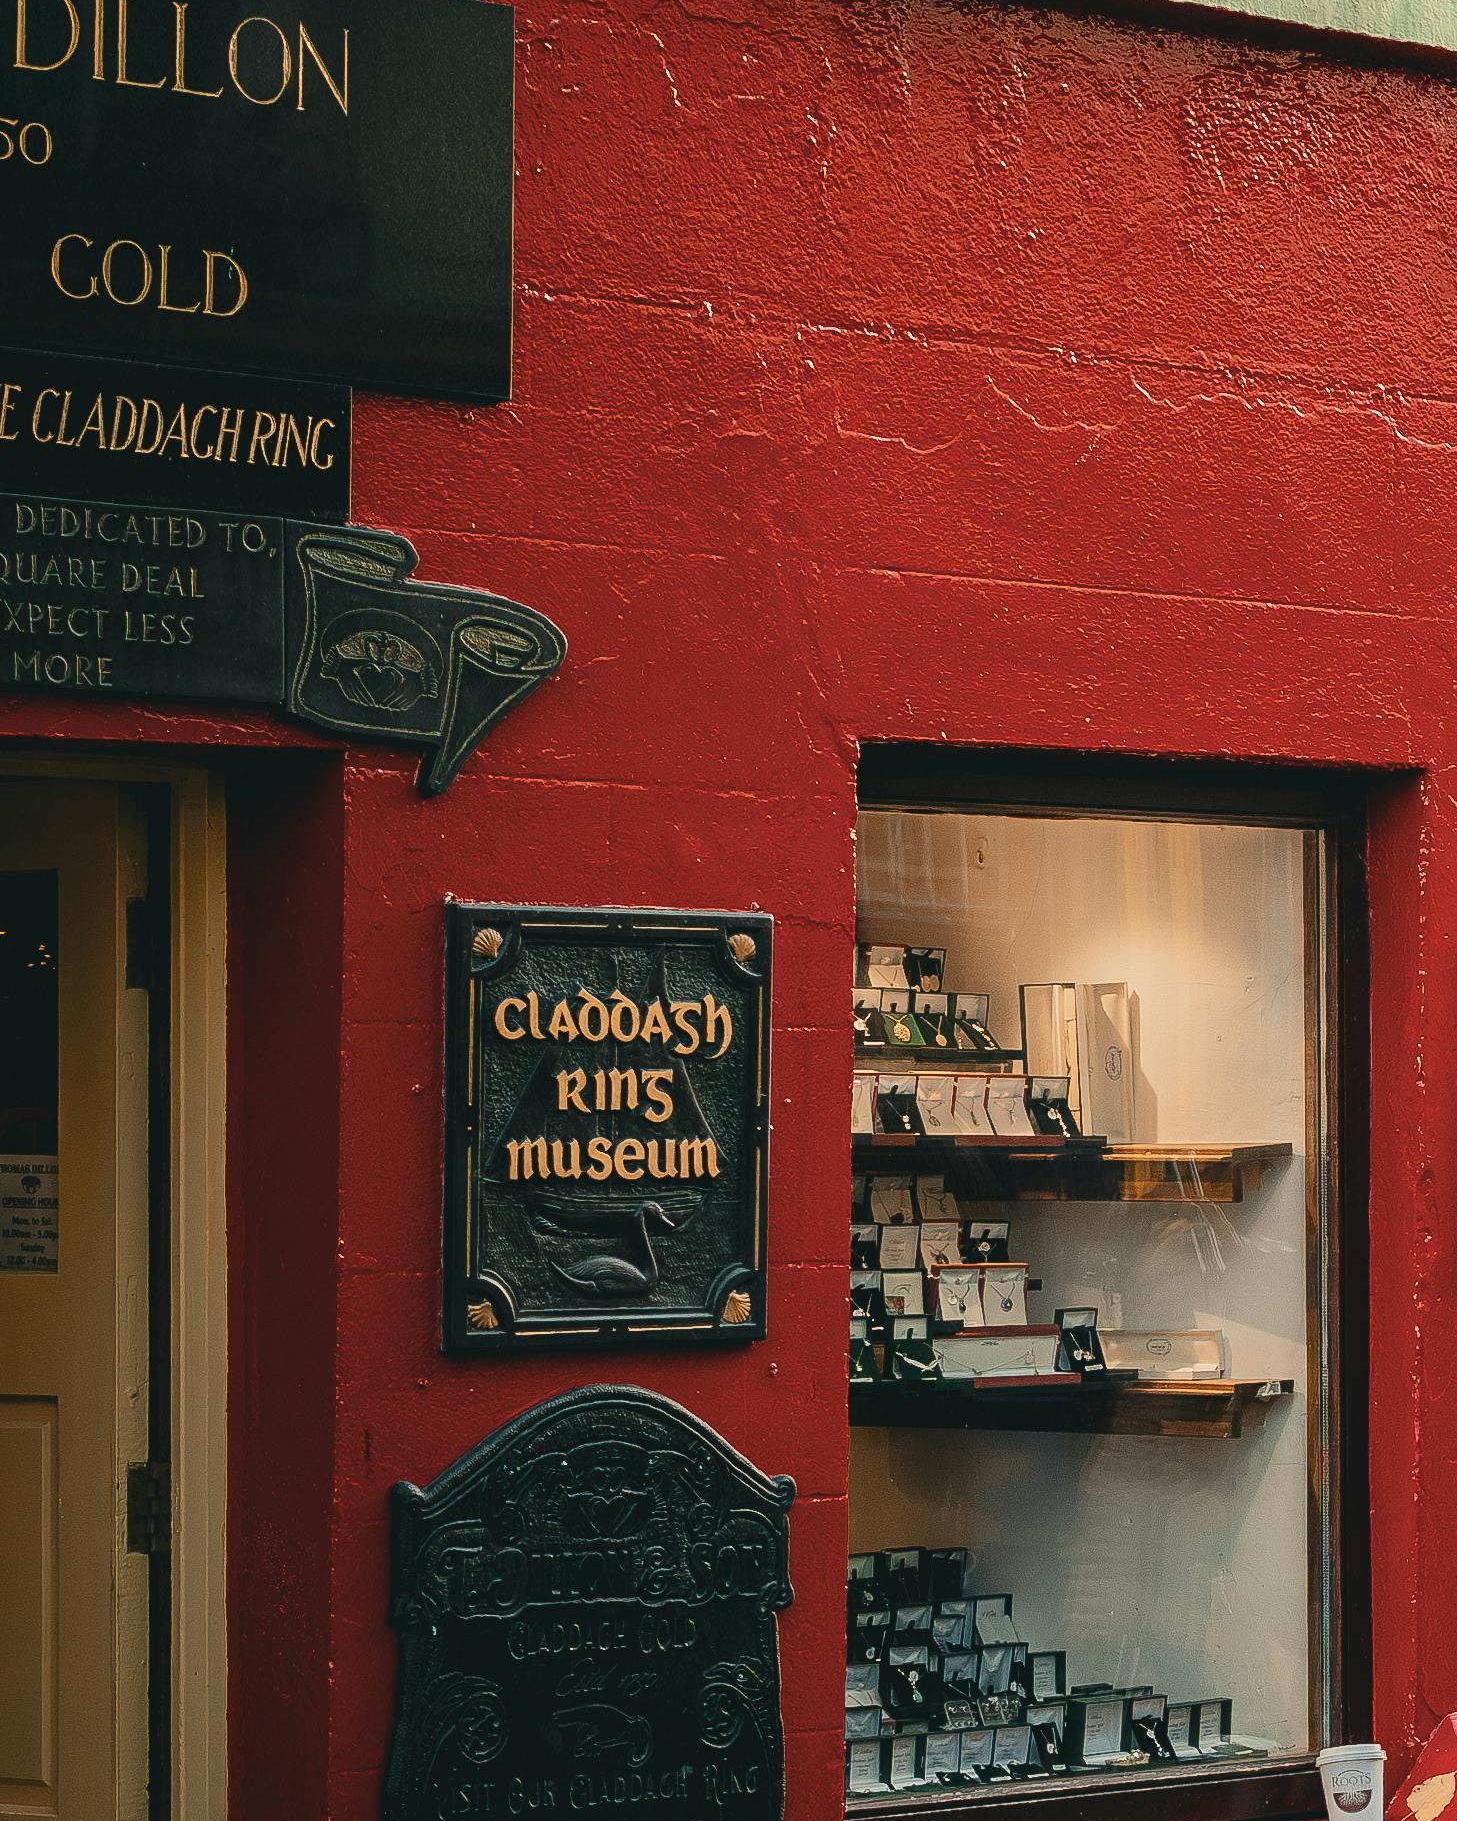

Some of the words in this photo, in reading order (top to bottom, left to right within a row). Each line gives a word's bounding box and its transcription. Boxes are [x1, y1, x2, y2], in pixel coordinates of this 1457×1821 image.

[51, 233, 248, 317] GOLD
[32, 388, 244, 463] CLADDAGH
[247, 410, 336, 470] RING
[15, 503, 207, 549] DEDICATED
[122, 562, 205, 599] DEAL
[124, 610, 196, 646] LESS
[13, 650, 113, 688] MORE
